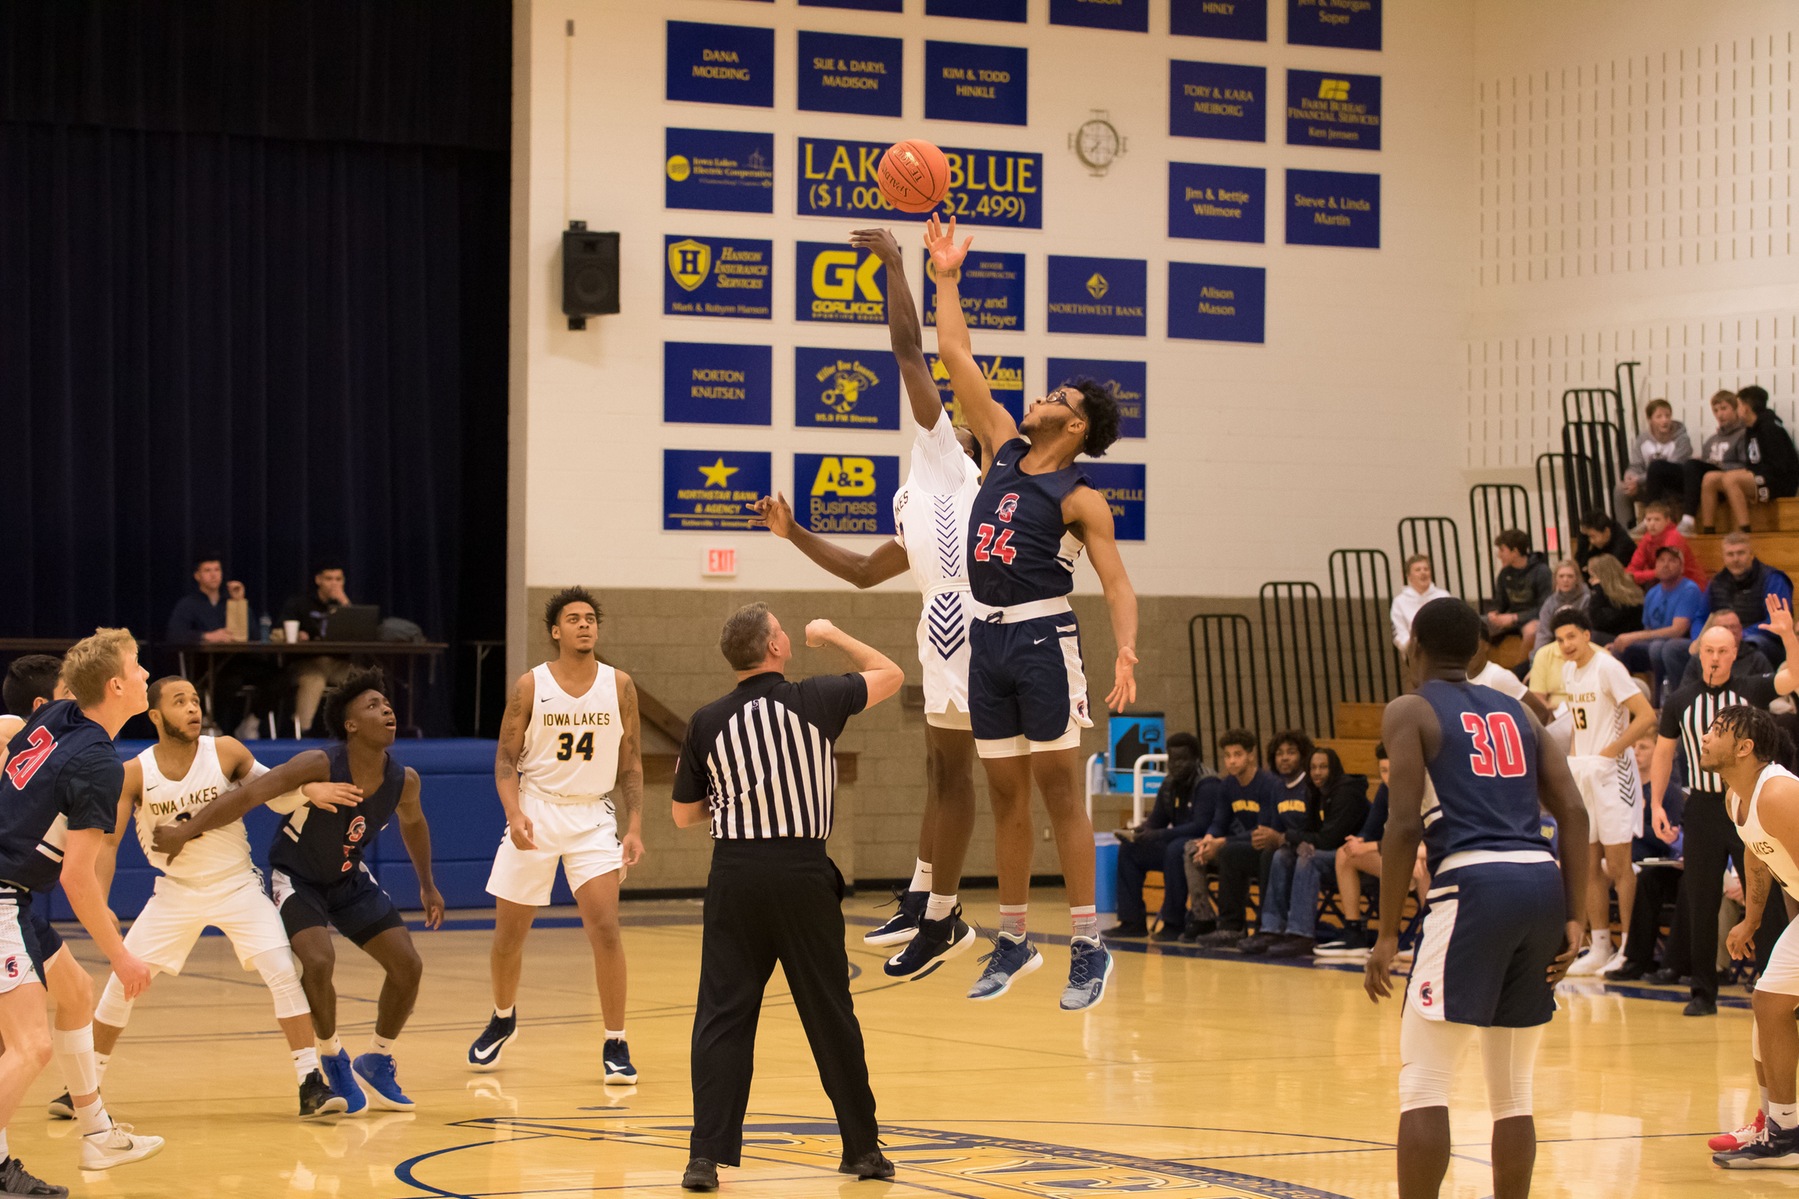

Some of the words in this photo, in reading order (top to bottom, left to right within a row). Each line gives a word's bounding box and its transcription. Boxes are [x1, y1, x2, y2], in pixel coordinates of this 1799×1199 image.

[1202, 3, 1235, 15] HINEY
[1319, 10, 1350, 25] Soper
[703, 49, 739, 63] DANA
[692, 65, 750, 81] MOEDING
[813, 57, 834, 70] SUE
[837, 60, 847, 71] &
[850, 60, 887, 75] DARYL
[822, 75, 878, 90] MADISON
[942, 67, 963, 80] KIM
[966, 69, 975, 81] &
[978, 70, 1010, 84] TODD
[956, 85, 996, 99] HINKLE
[1183, 84, 1208, 98] TORY
[1211, 86, 1222, 99] &
[1224, 88, 1254, 102] KARA
[1194, 102, 1243, 117] MEIBORG
[805, 144, 880, 182] LAK
[945, 152, 1038, 193] BLUE
[1185, 187, 1202, 201] Jim
[1205, 189, 1215, 200] &
[942, 191, 1026, 222] $2,499)
[1294, 194, 1325, 209] Steve
[1328, 197, 1338, 209] &
[1340, 197, 1371, 211] Linda
[1193, 204, 1242, 219] Willmore
[1314, 212, 1351, 226] Martin
[679, 250, 701, 275] H
[1201, 287, 1234, 300] Alison
[695, 302, 703, 312] &
[812, 300, 884, 315] GOALKICK
[960, 297, 982, 311] ory
[984, 296, 1008, 309] and
[1049, 303, 1113, 316] NORTHWEST
[1115, 305, 1144, 317] BANK
[1198, 302, 1235, 316] Mason
[980, 312, 1017, 329] Hoyer
[692, 368, 745, 383] NORTON
[691, 385, 745, 400] KNUTSEN
[835, 413, 849, 422] FM
[810, 457, 876, 497] A&B
[677, 489, 732, 500] NORTHSTAR
[732, 490, 759, 501] BANK
[1098, 487, 1145, 500] ICHELLE
[694, 503, 703, 514] &
[704, 503, 742, 514] AGENCY
[810, 498, 877, 515] Business
[810, 515, 877, 532] Solutions
[974, 522, 1017, 565] 24
[708, 549, 735, 572] EXIT
[543, 713, 570, 726] IOWA
[573, 712, 610, 726] LAKES
[556, 731, 595, 762] 34
[1460, 711, 1527, 778] 30
